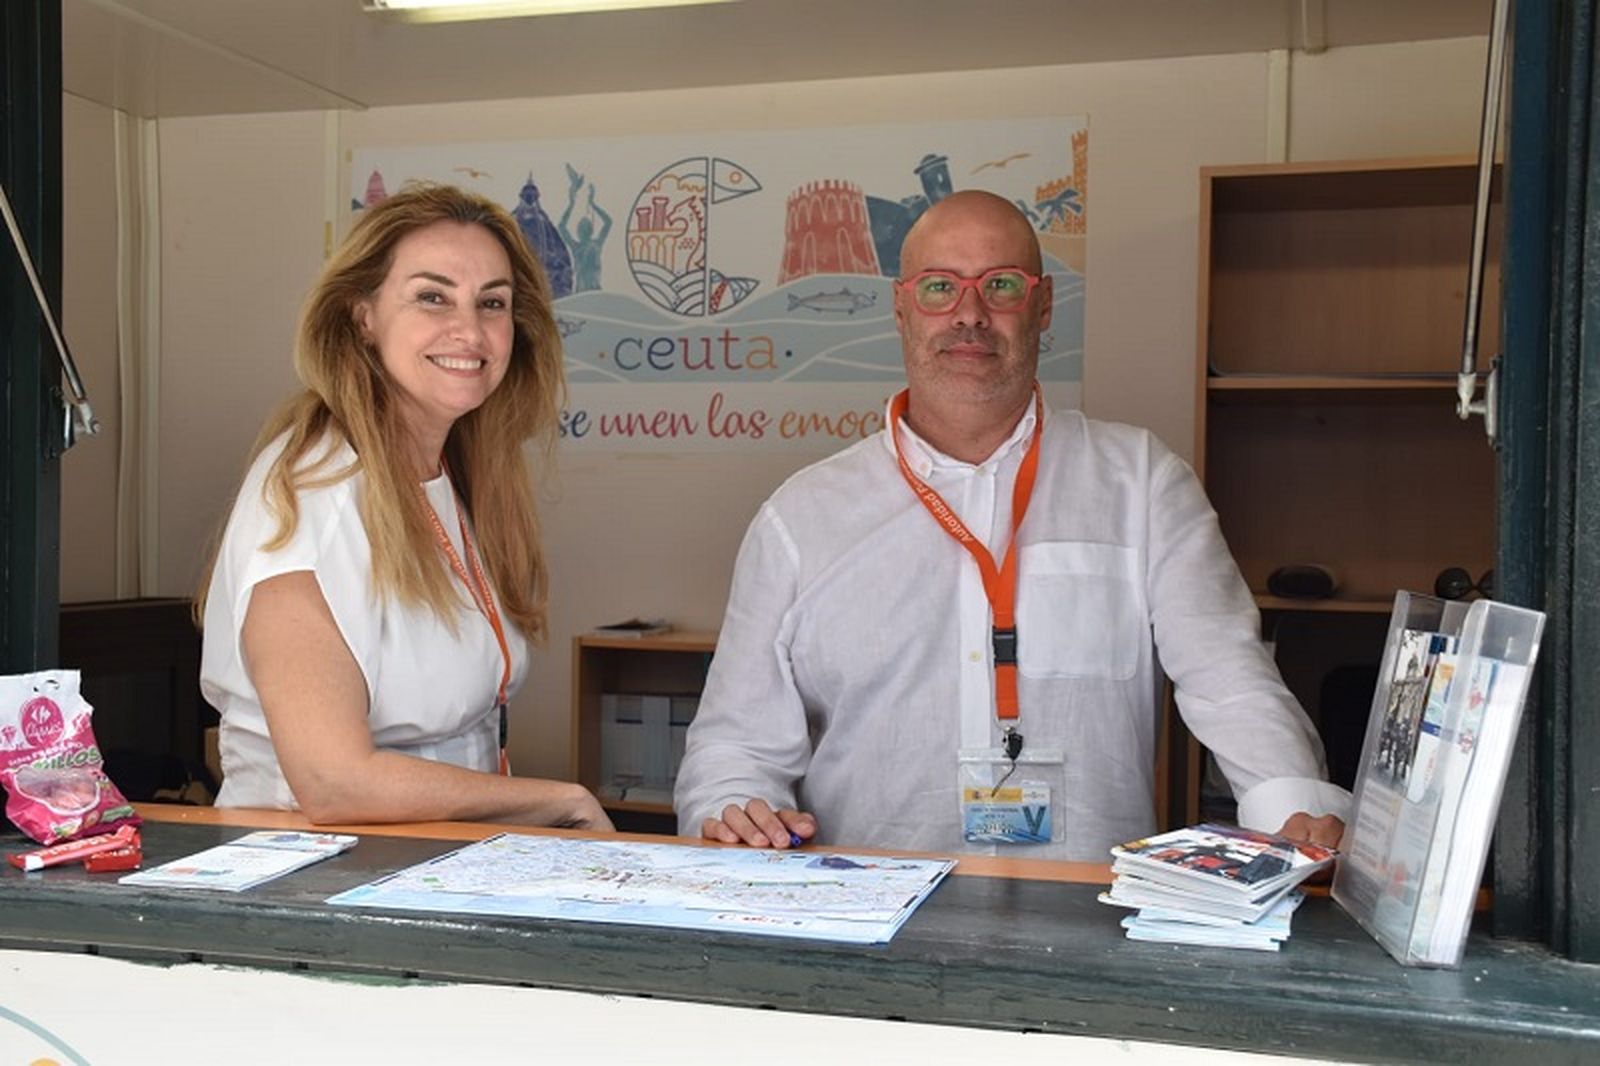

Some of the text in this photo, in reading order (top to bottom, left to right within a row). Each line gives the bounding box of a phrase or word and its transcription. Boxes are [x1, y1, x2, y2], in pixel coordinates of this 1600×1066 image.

[613, 328, 779, 371] ceuta
[600, 410, 698, 438] unen
[707, 392, 773, 438] las
[925, 492, 975, 542] Autoridad
